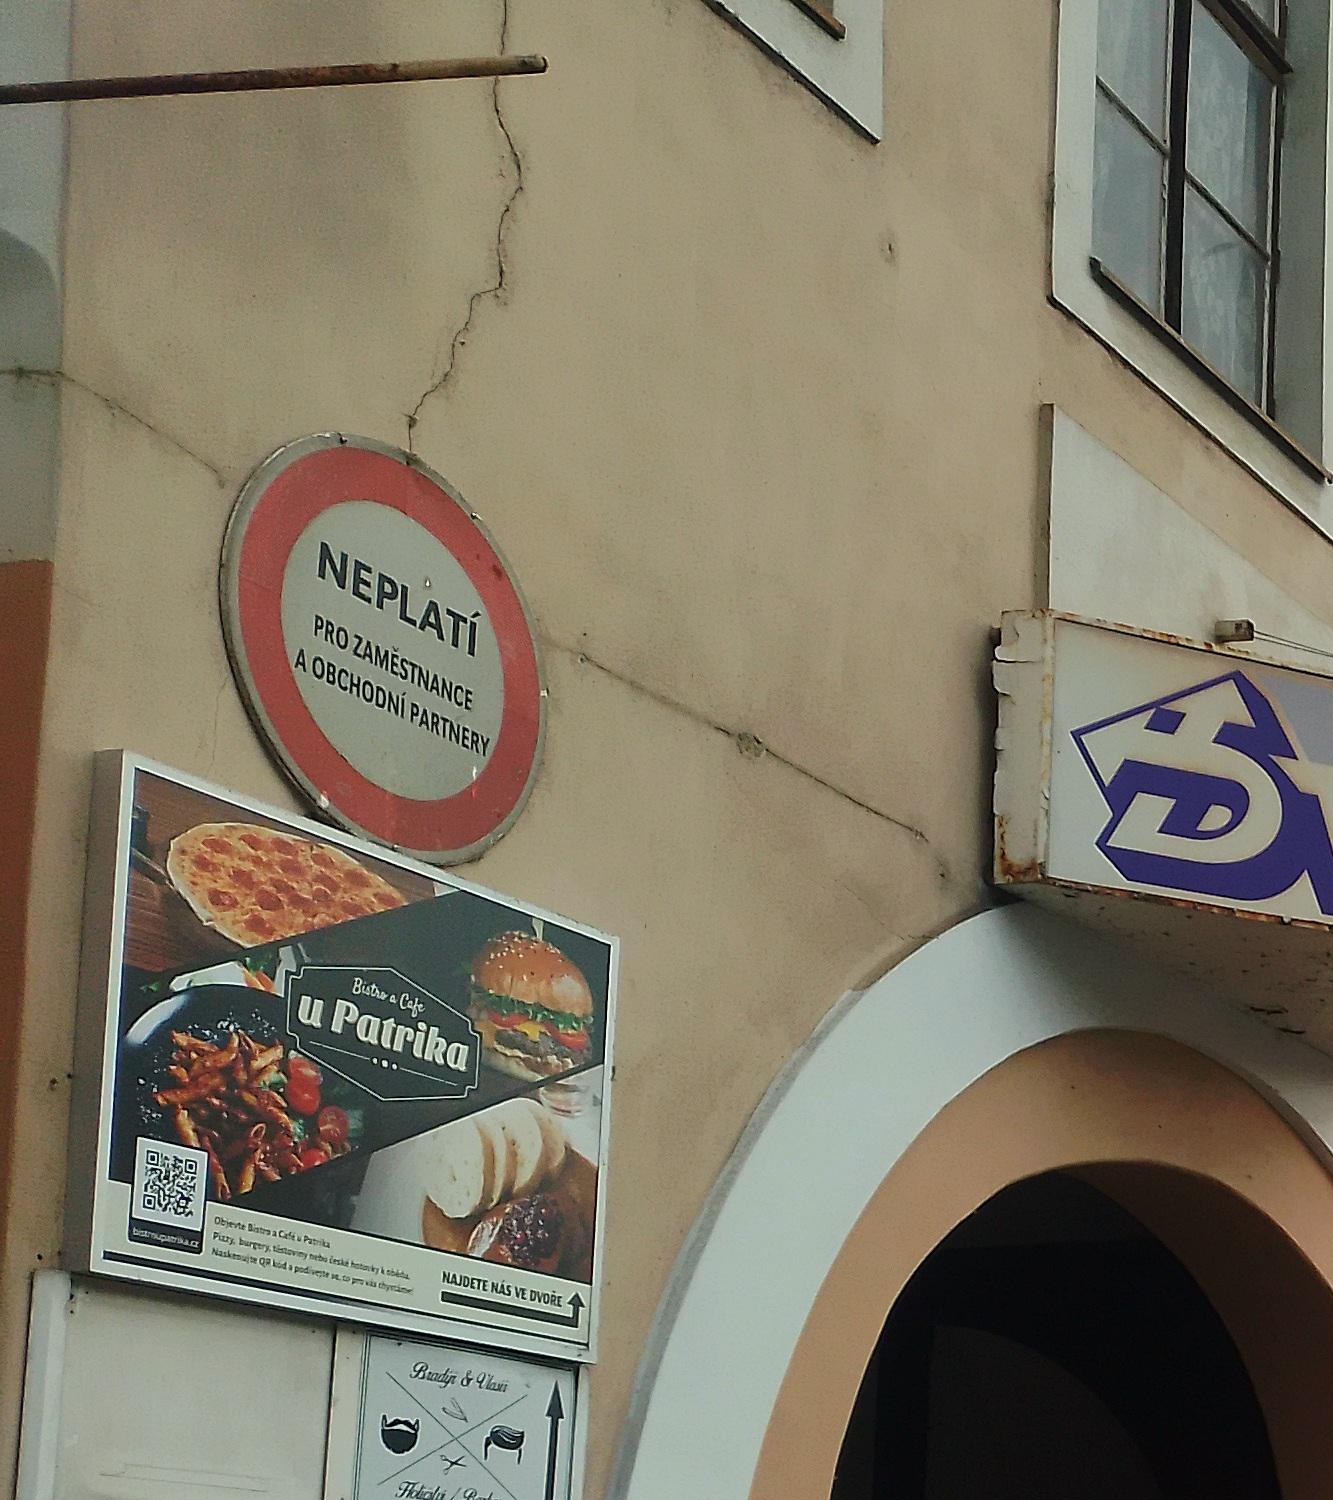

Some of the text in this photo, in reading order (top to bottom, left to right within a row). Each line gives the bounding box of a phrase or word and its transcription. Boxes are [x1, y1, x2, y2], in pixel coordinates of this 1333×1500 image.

[318, 541, 481, 657] NEPLATÍ
[295, 648, 490, 757] A OBCHODNÍ PARTNERY
[314, 614, 473, 711] PRO ZAMĚSTNANCE
[298, 996, 470, 1072] u Patrika
[442, 1270, 562, 1308] NAJDETE NÁS VE DVOŘE
